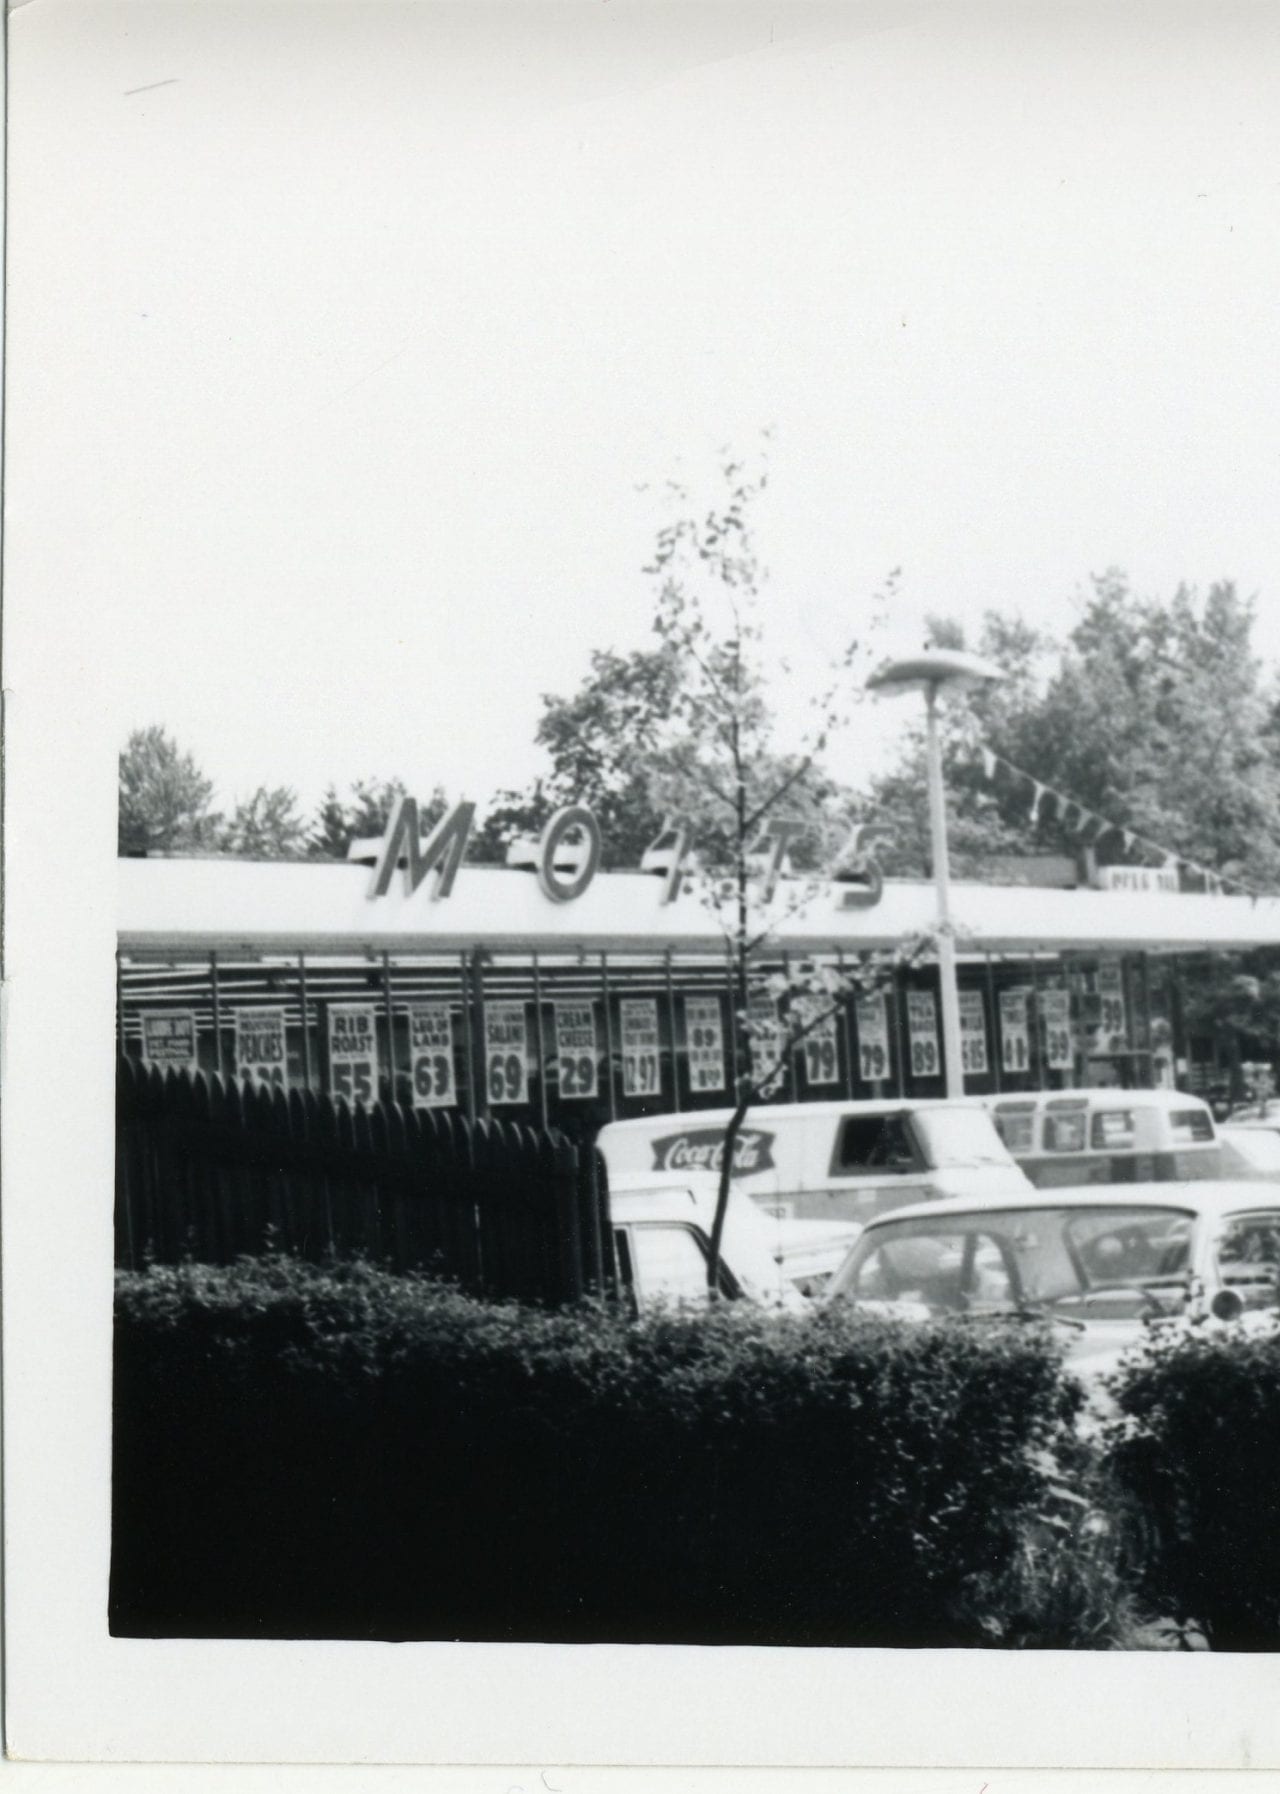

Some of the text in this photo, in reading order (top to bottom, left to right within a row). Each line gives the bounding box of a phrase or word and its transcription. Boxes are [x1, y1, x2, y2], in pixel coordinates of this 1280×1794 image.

[334, 1016, 369, 1034] RIB
[412, 1019, 434, 1033] LEG
[557, 1011, 592, 1028] CREAM
[239, 1033, 283, 1064] PEACHES
[331, 1035, 373, 1052] ROAST
[412, 1034, 449, 1047] LAMB
[559, 1030, 594, 1048] CHEESE
[806, 1040, 835, 1080] 79
[861, 1043, 885, 1077] 79
[913, 1041, 936, 1073] 89
[332, 1062, 372, 1103] 55
[414, 1055, 450, 1097] 63
[489, 1054, 522, 1101] 69
[560, 1056, 595, 1095] 29
